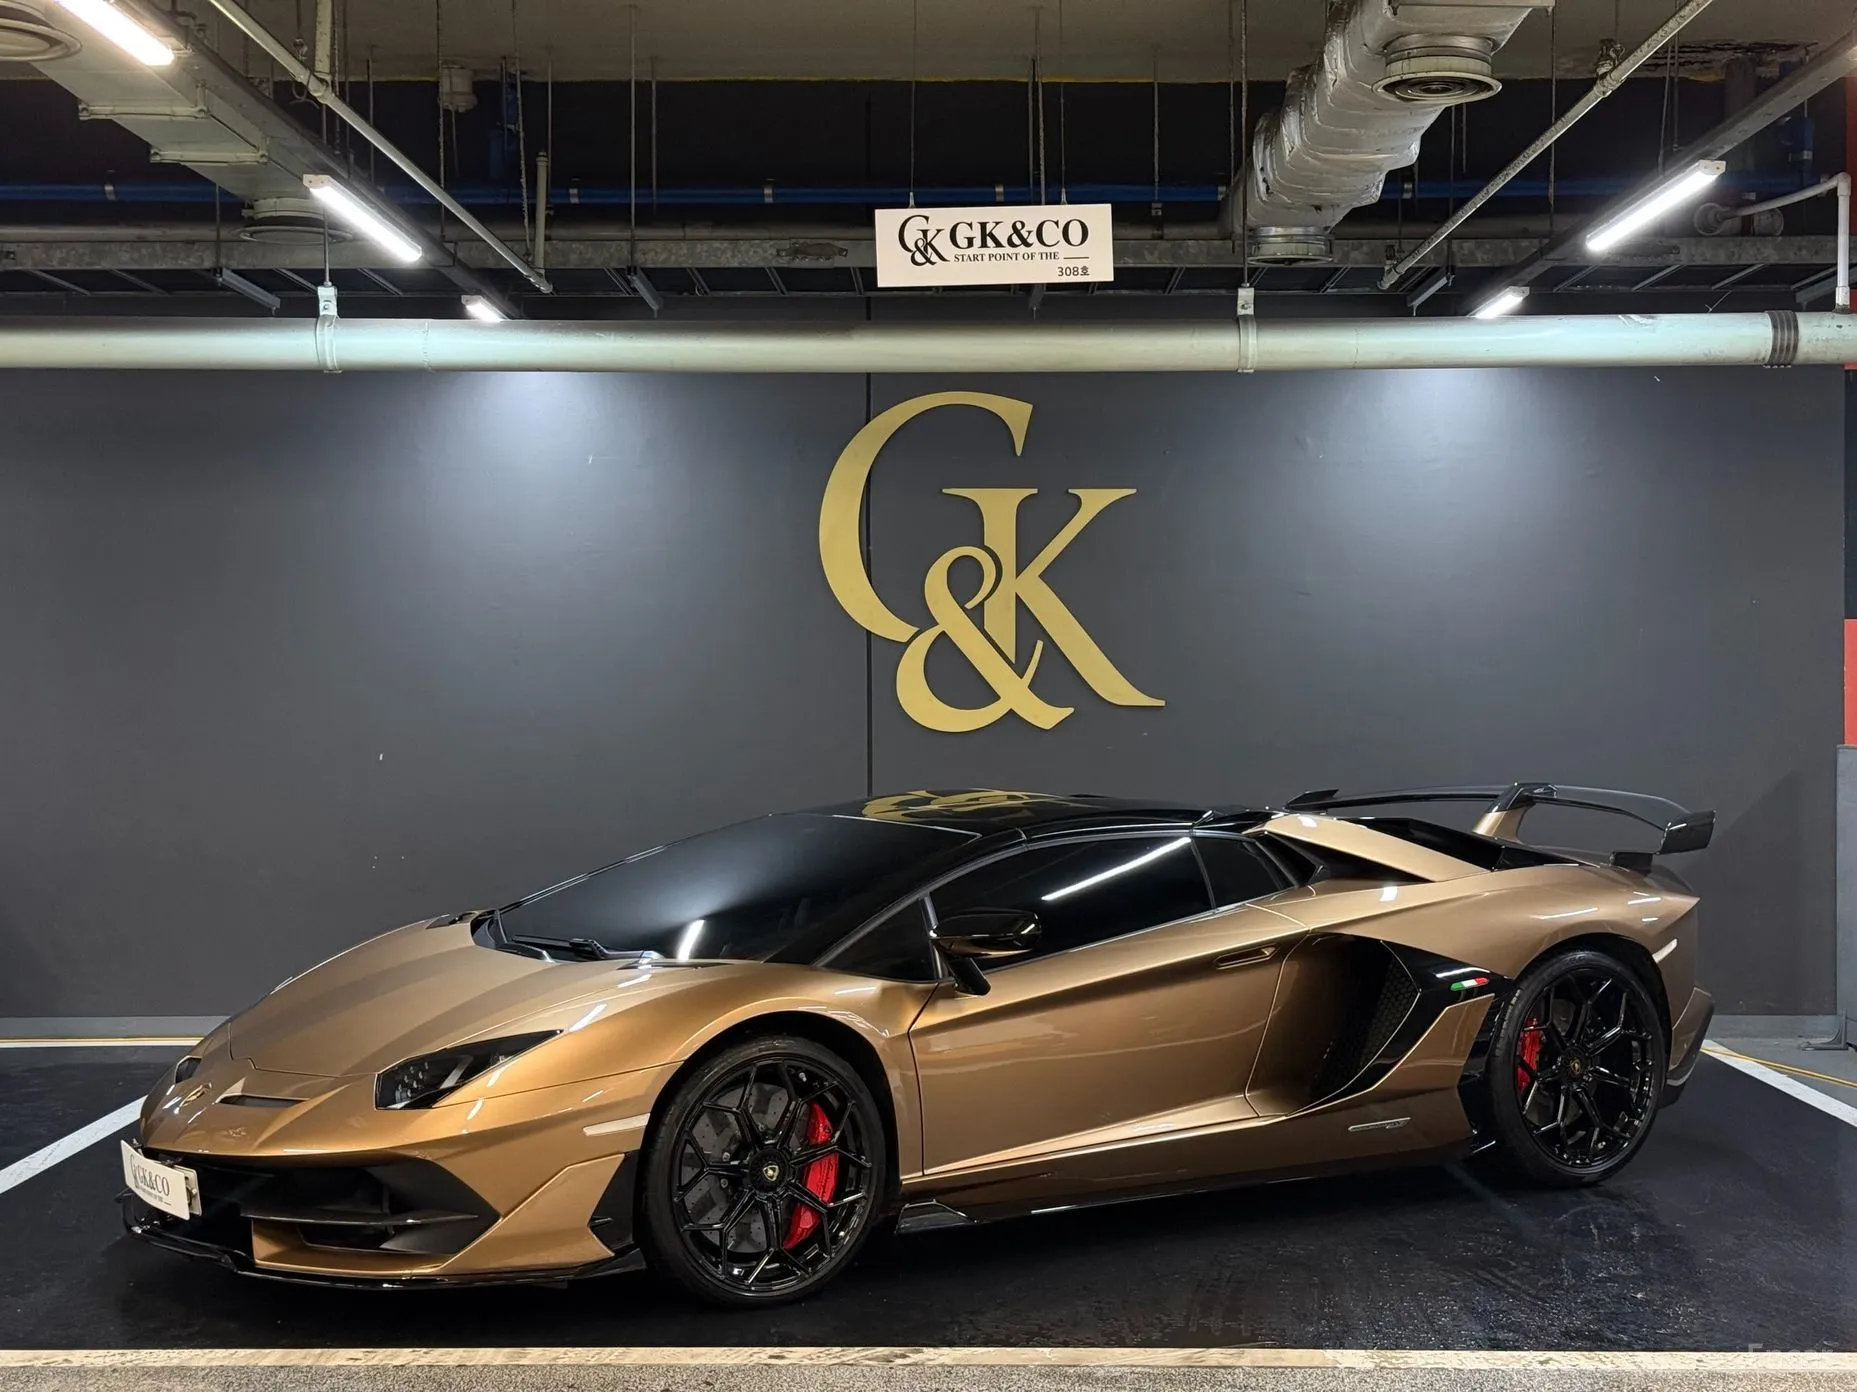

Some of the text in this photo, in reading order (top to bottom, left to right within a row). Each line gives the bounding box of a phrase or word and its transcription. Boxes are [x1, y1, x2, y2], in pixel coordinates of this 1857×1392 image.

[950, 219, 1089, 249] GK&CO
[954, 251, 1060, 262] START POINT OF THE
[1057, 265, 1090, 277] 308호
[137, 1163, 170, 1197] GK&CO
